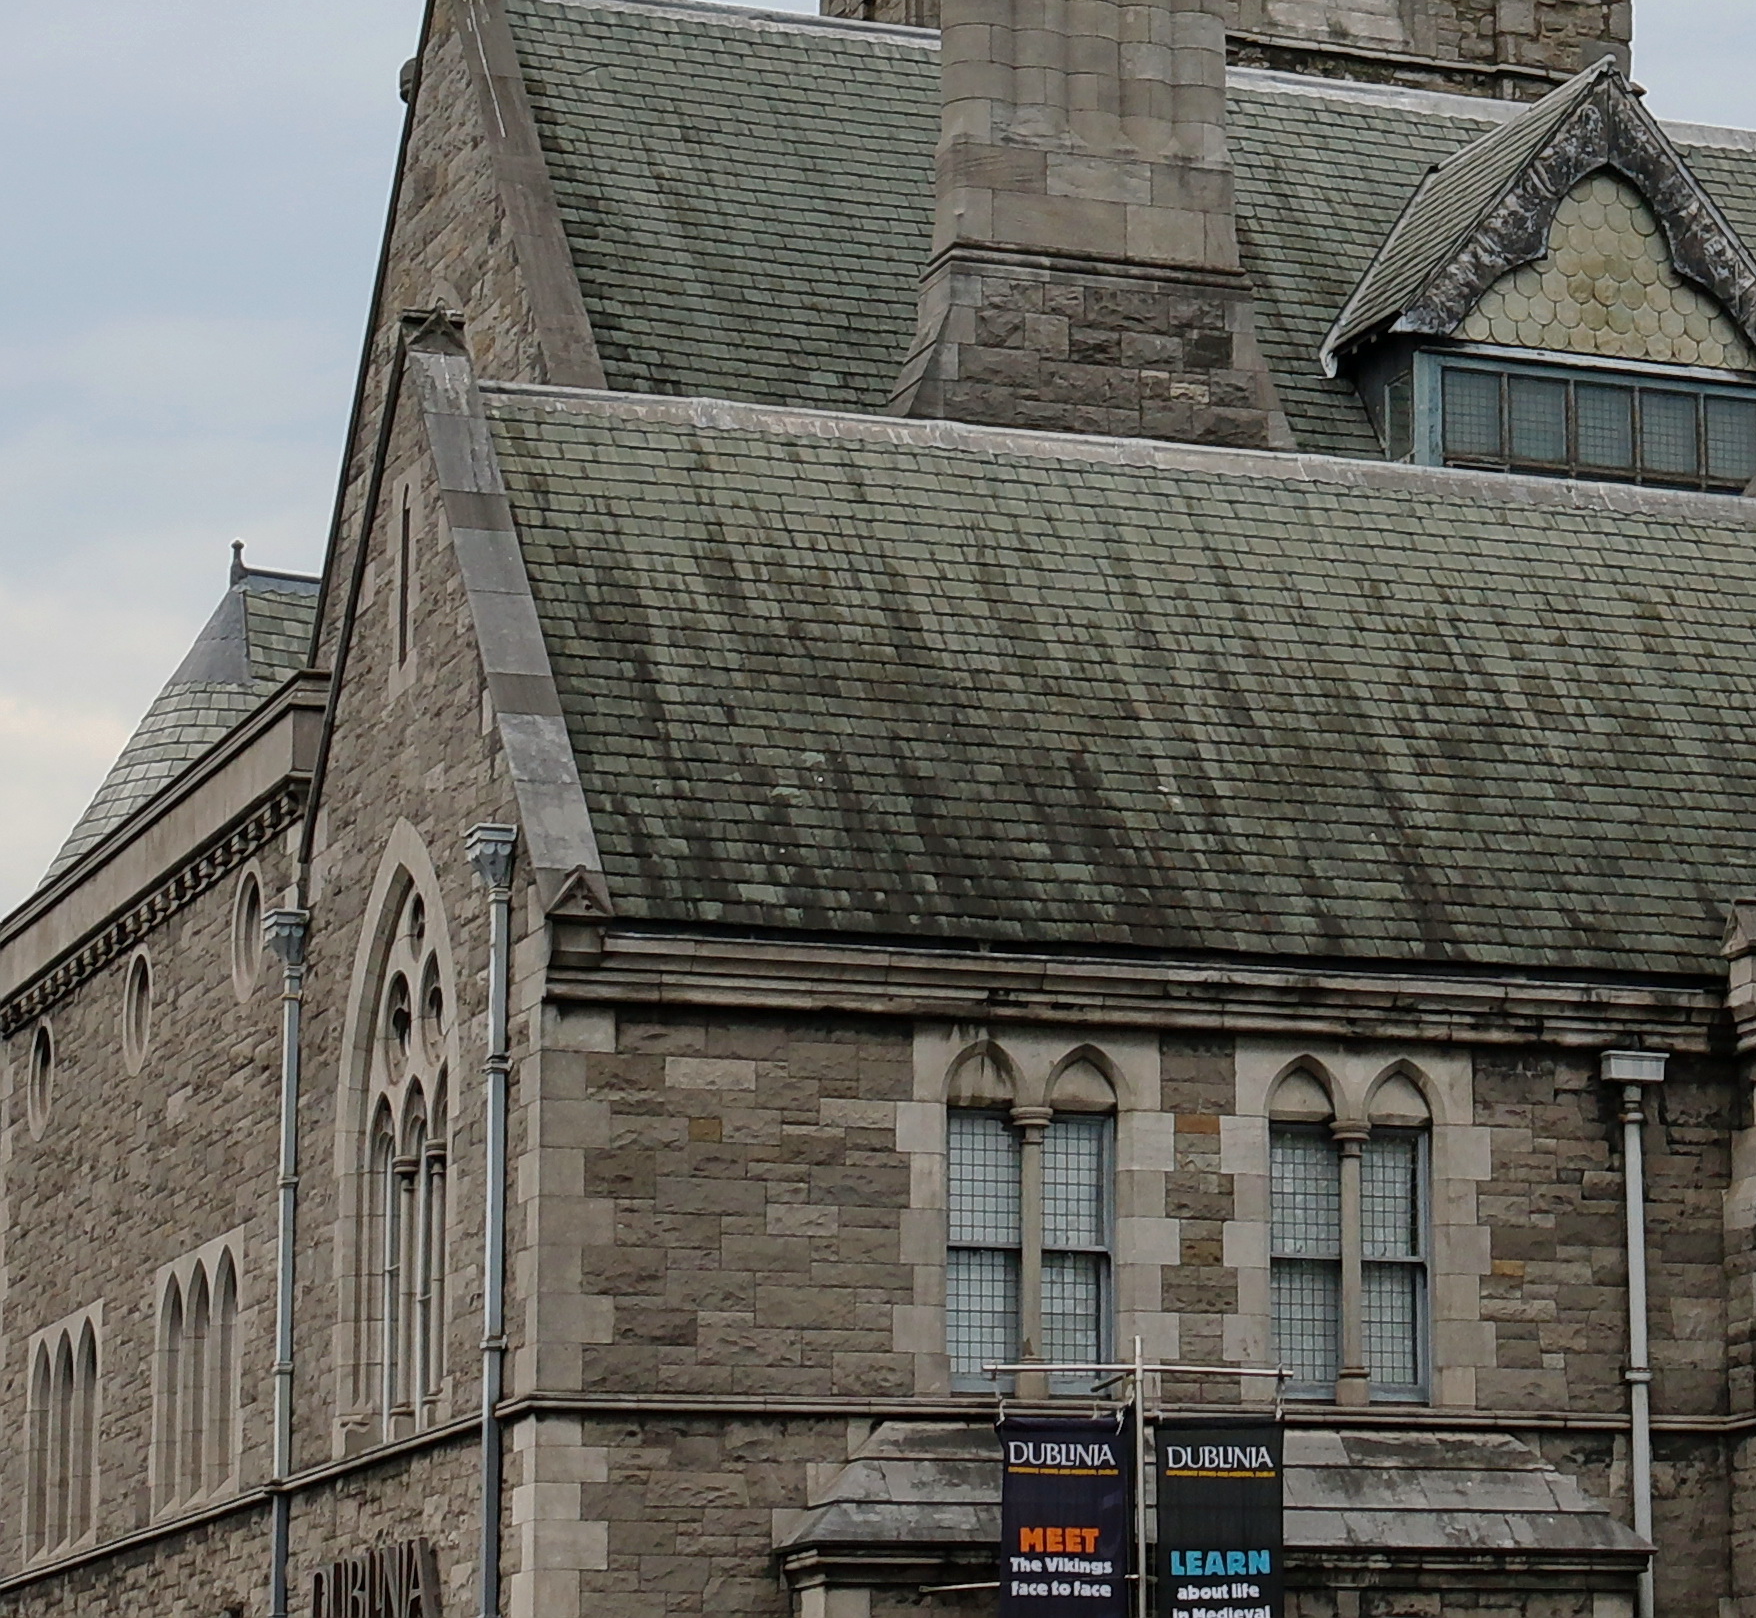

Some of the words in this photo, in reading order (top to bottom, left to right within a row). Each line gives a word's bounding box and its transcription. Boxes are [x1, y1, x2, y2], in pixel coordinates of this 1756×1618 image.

[1008, 1441, 1116, 1466] DUBLINIA
[1166, 1445, 1274, 1469] DUBLINIA
[1020, 1527, 1099, 1553] MEET
[1009, 1556, 1043, 1573] The
[1044, 1556, 1113, 1576] Vikings
[1170, 1549, 1270, 1576] LEARN
[1011, 1580, 1048, 1597] face
[1051, 1580, 1071, 1596] to
[1073, 1580, 1112, 1597] face
[1177, 1584, 1229, 1600] about
[1231, 1582, 1260, 1599] life
[1191, 1605, 1271, 1618] Medieval
